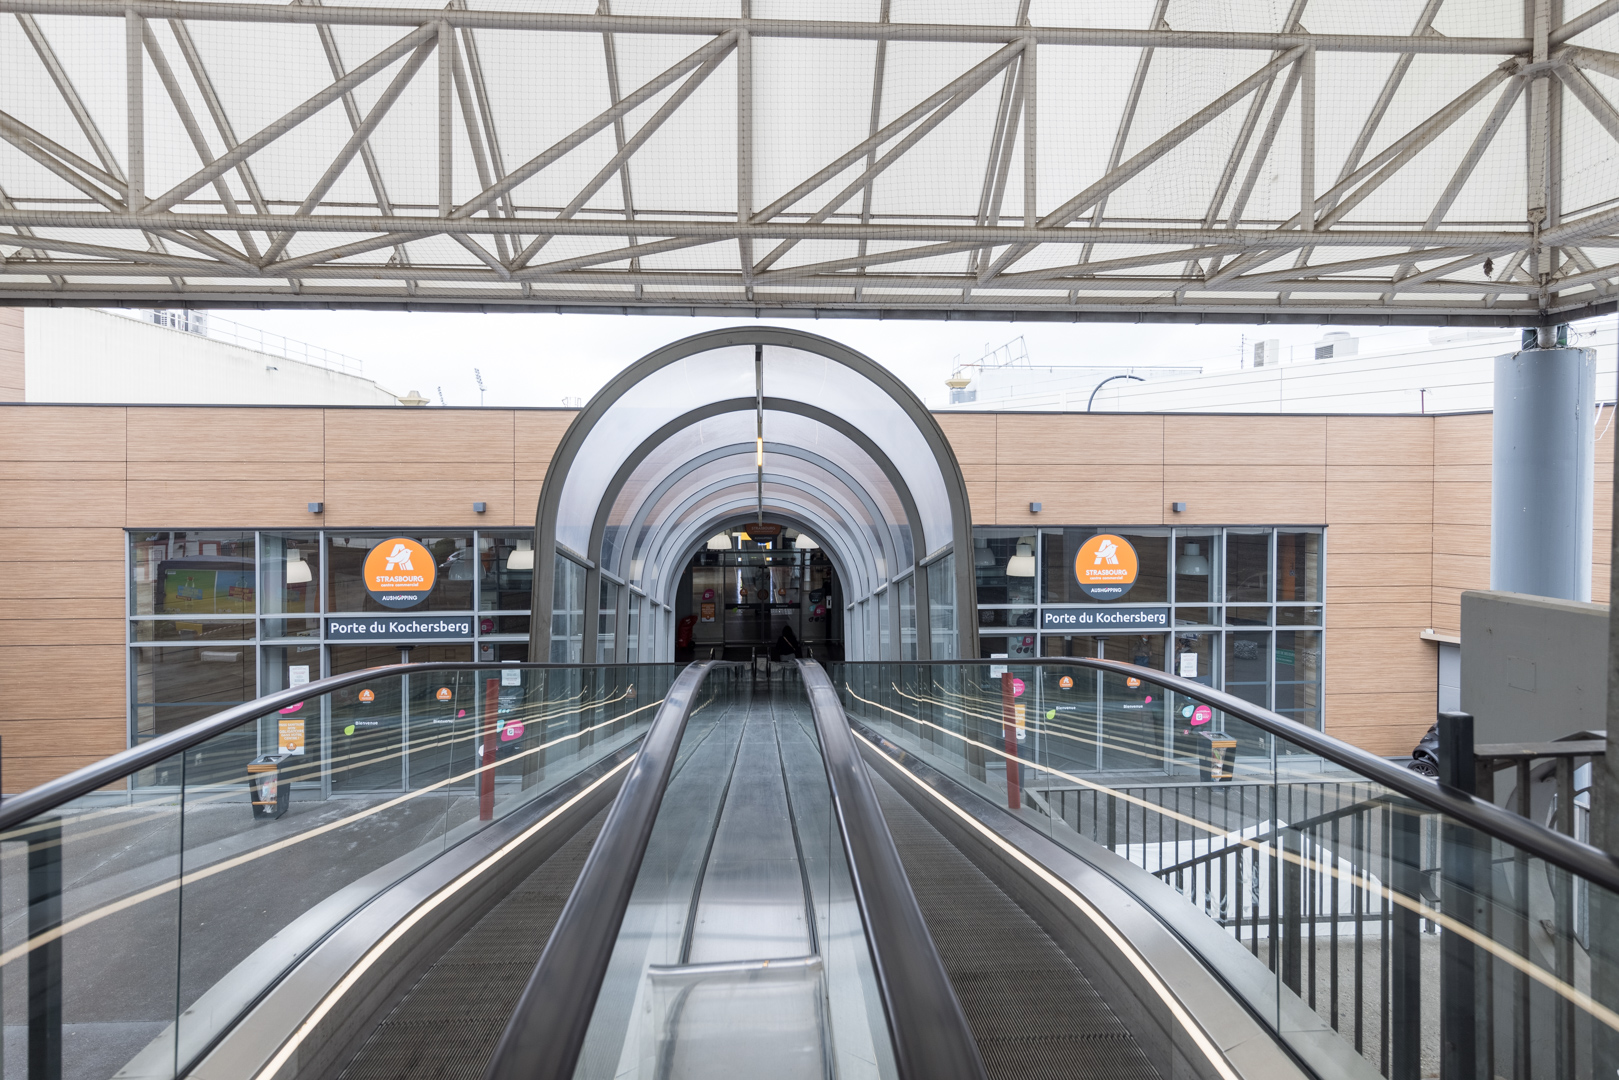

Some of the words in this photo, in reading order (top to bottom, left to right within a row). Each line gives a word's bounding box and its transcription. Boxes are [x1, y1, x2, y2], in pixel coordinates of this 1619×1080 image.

[375, 575, 424, 583] STRASBOURG
[1045, 613, 1077, 624] Porte
[1079, 611, 1094, 623] du
[1096, 611, 1166, 625] Kochersberg
[330, 622, 367, 634] Porte
[369, 621, 386, 633] du
[389, 620, 469, 635] Kochersberg
